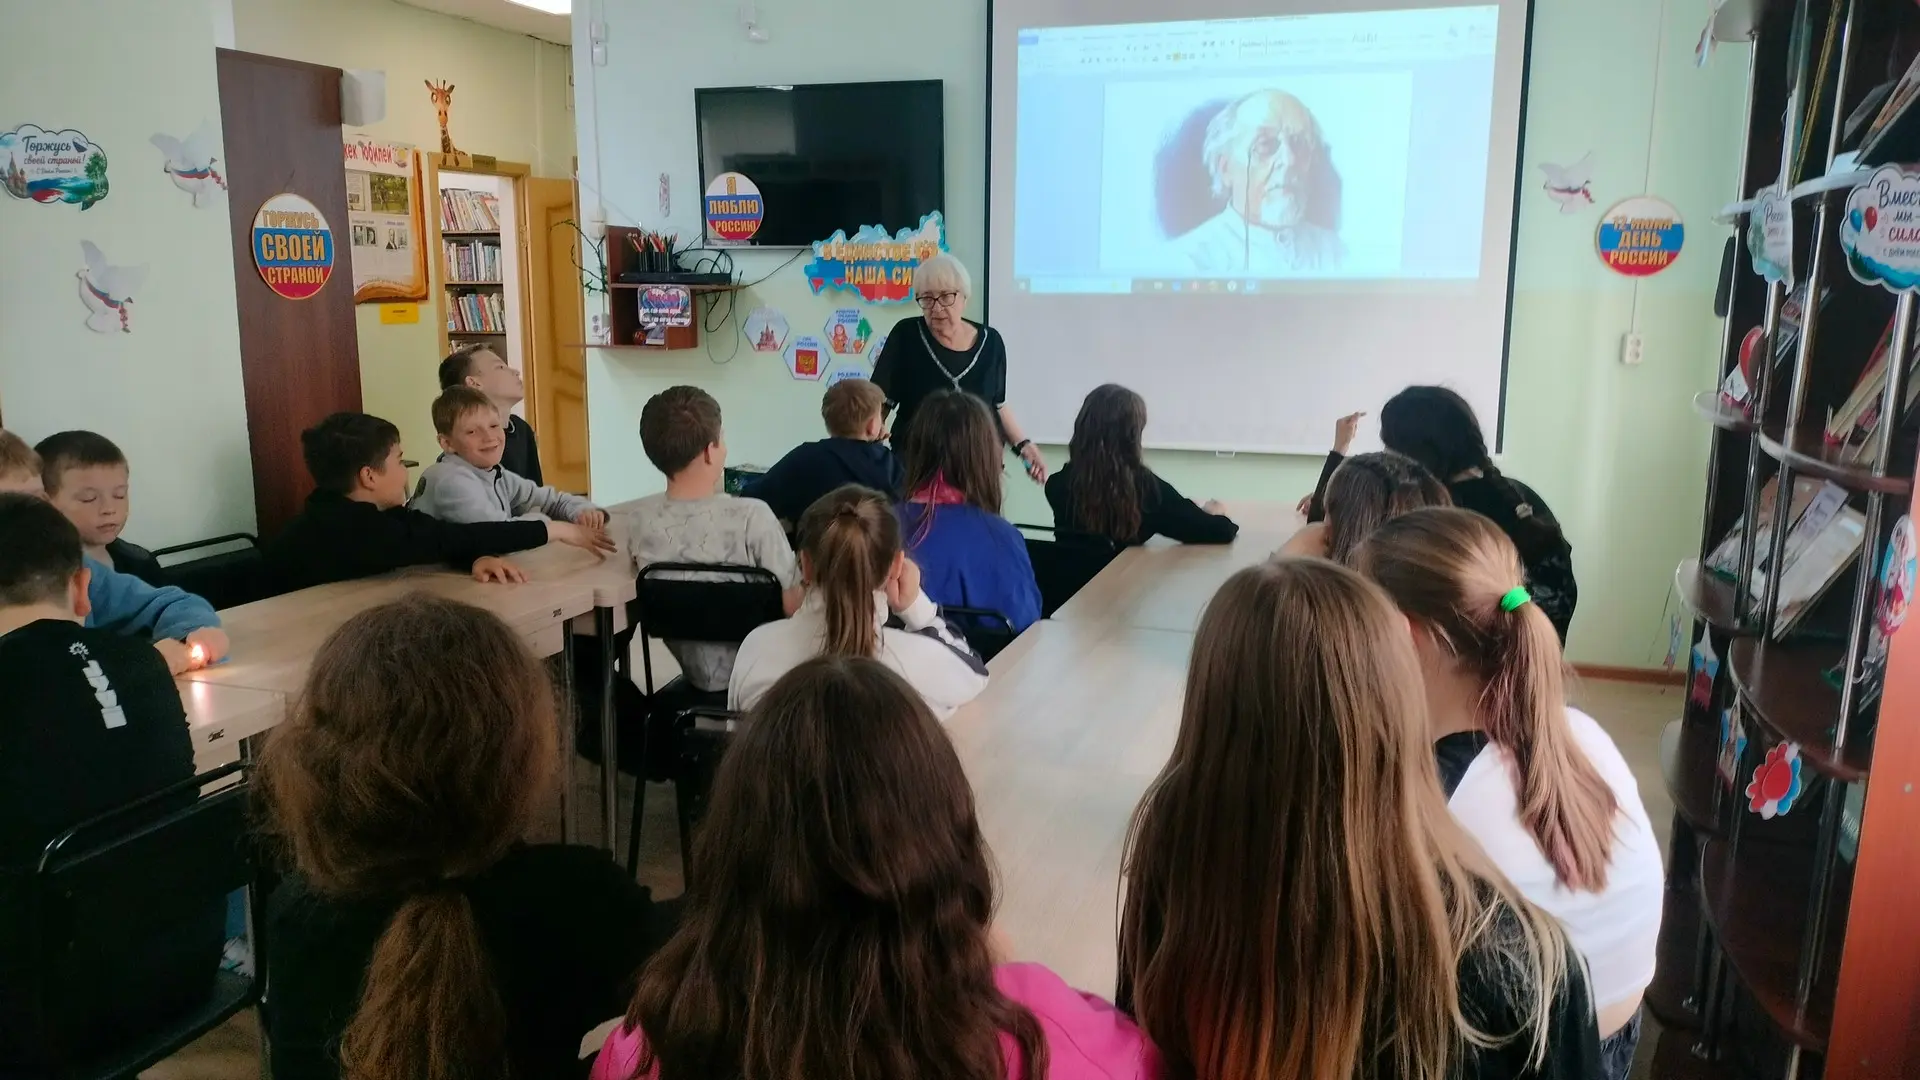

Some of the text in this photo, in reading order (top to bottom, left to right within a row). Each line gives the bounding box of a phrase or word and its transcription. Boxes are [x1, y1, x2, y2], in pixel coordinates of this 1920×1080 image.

[709, 199, 759, 214] ЛЮБЛЮ
[262, 209, 320, 229] ГОРЖУСЬ
[715, 220, 756, 232] РОССИЮ
[1612, 214, 1628, 230] 12
[261, 230, 325, 261] СВОЕЙ
[1618, 231, 1662, 249] ДЕНЬ
[823, 242, 911, 264] В ЕДИНСТВЕ
[1609, 249, 1668, 265] РОССИИ
[267, 265, 324, 284] СТРАНОЙ
[845, 265, 912, 285] НАША СИ
